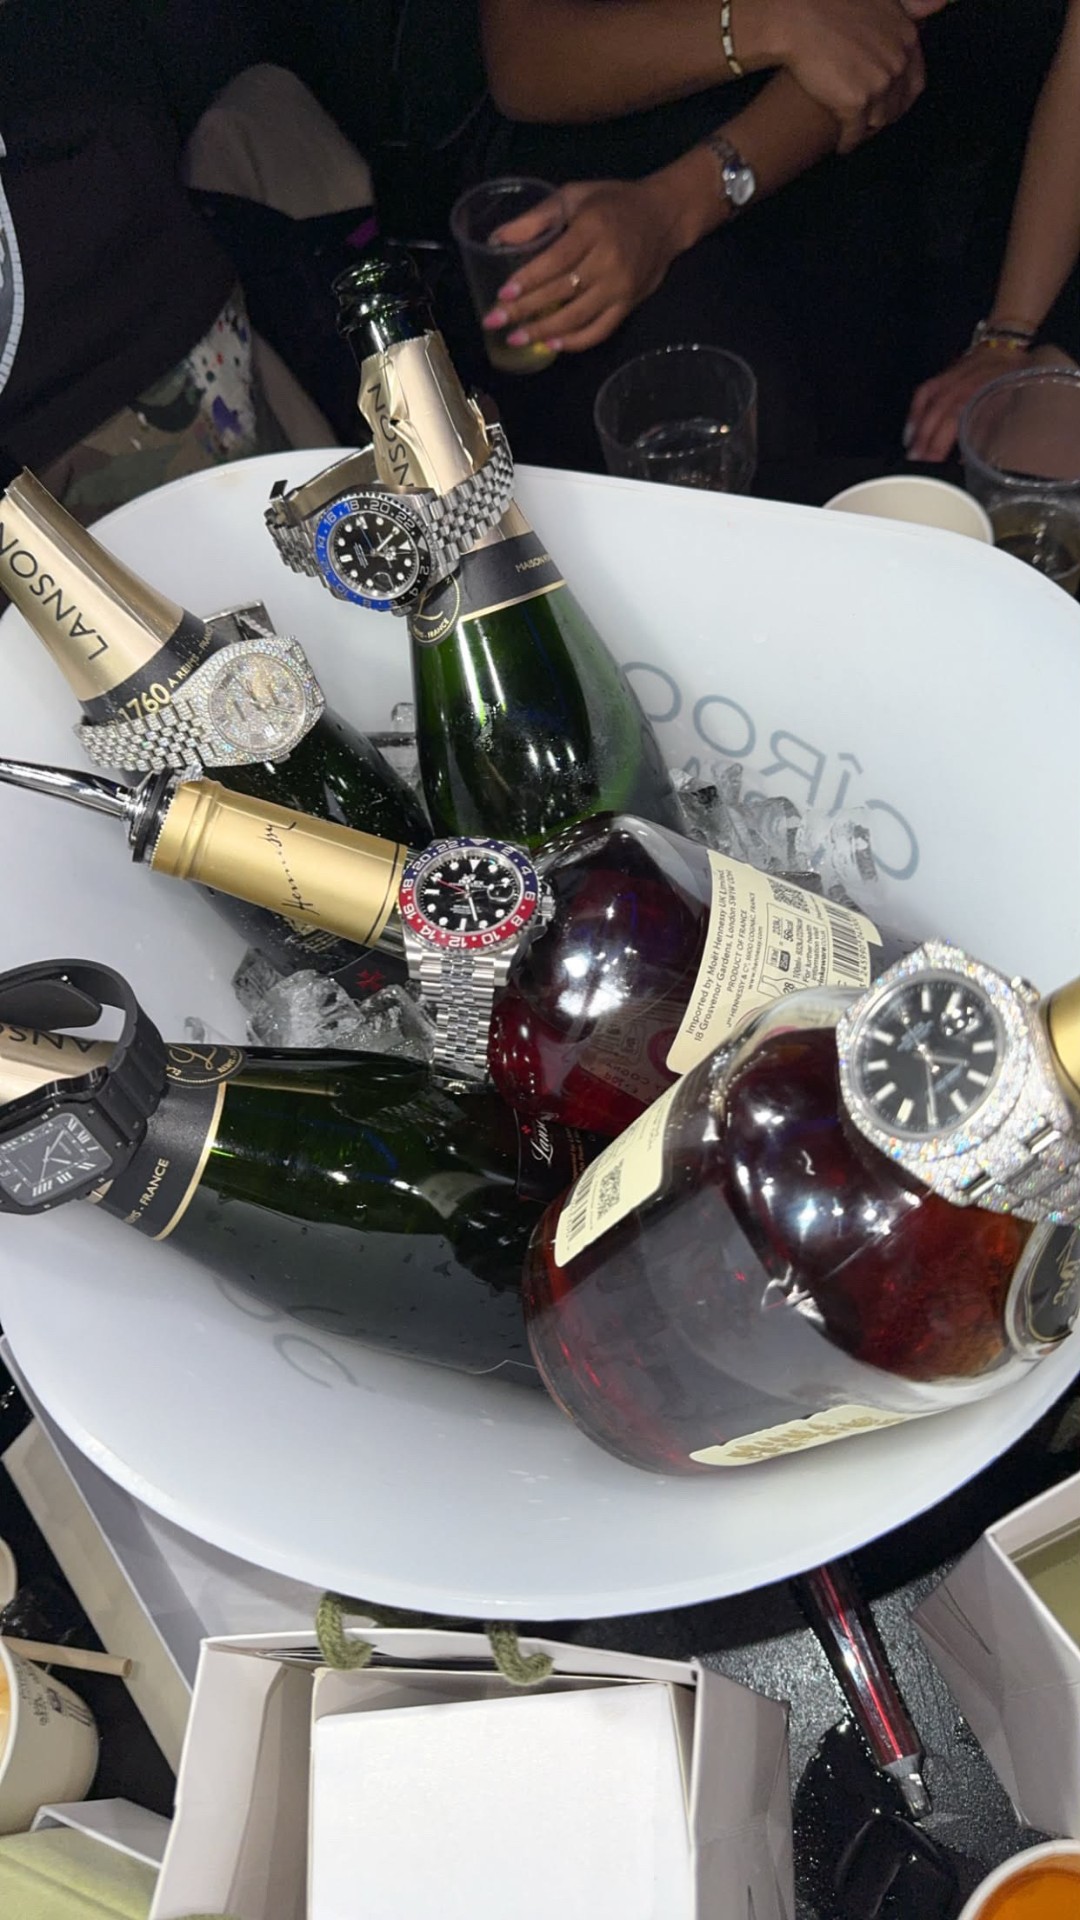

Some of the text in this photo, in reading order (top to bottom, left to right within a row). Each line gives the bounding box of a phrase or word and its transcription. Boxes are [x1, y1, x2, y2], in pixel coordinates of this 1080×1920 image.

[344, 500, 359, 512] 18
[369, 501, 391, 514] 20
[395, 511, 416, 530] 22
[420, 566, 429, 575] 2
[118, 683, 171, 721] 1760
[436, 840, 459, 853] 22
[500, 846, 513, 856] 2
[411, 853, 431, 870] 20
[521, 866, 532, 876] 4
[402, 878, 414, 894] 18
[525, 891, 535, 901] 6
[719, 895, 727, 908] UK
[402, 905, 415, 920] 16
[511, 915, 523, 927] 8
[419, 925, 436, 940] 14
[713, 910, 727, 949] Hennessy
[448, 937, 467, 948] 12
[481, 931, 501, 944] 10
[727, 909, 747, 993] PRODUCT OF FRANCE
[694, 1031, 704, 1042] 18
[699, 982, 722, 1030] Grosvenor
[726, 907, 736, 938] London
[802, 969, 811, 983] For
[703, 977, 714, 989] by
[730, 981, 745, 1017] HENNESSY
[685, 989, 709, 1034] Imported
[139, 1157, 170, 1207] FRANCE
